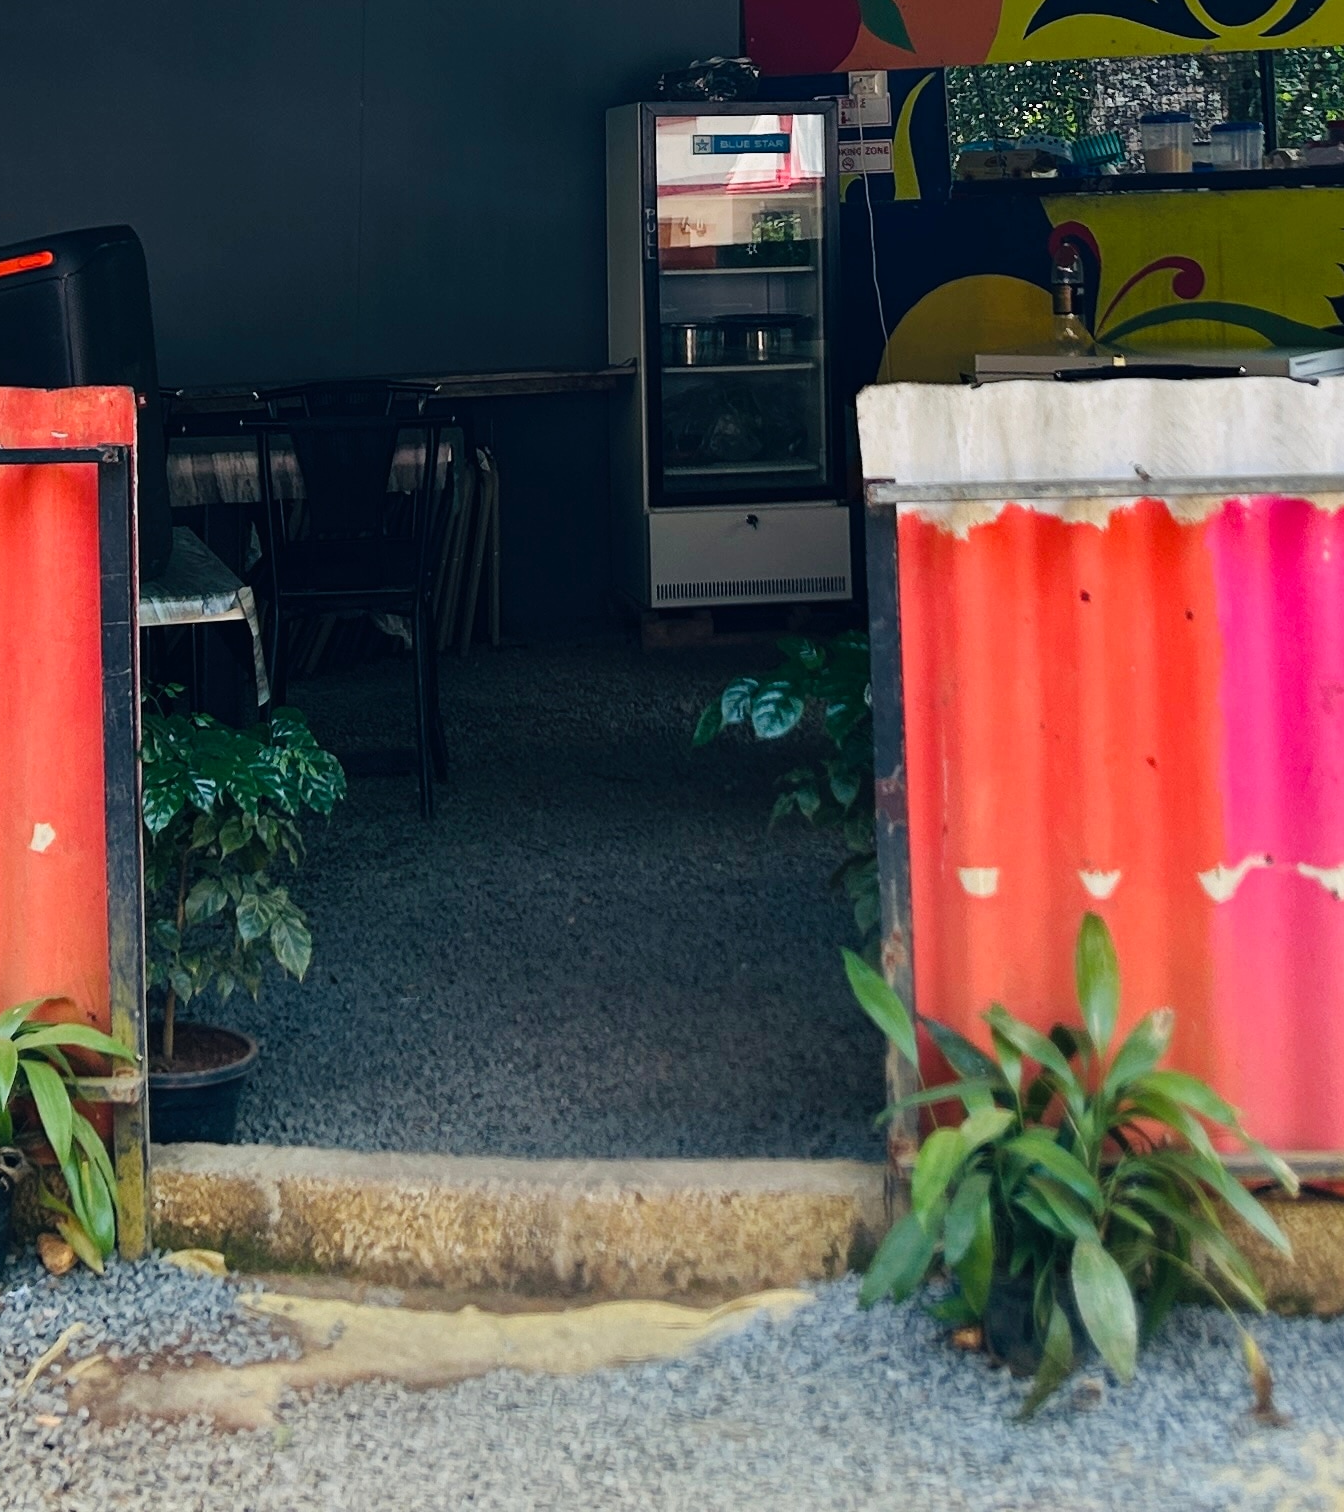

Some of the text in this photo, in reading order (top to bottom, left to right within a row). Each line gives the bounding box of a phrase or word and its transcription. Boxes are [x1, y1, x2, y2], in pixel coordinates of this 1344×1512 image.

[720, 139, 784, 148] BLUE STAR
[865, 146, 889, 155] ZONE
[645, 208, 656, 259] PULL
